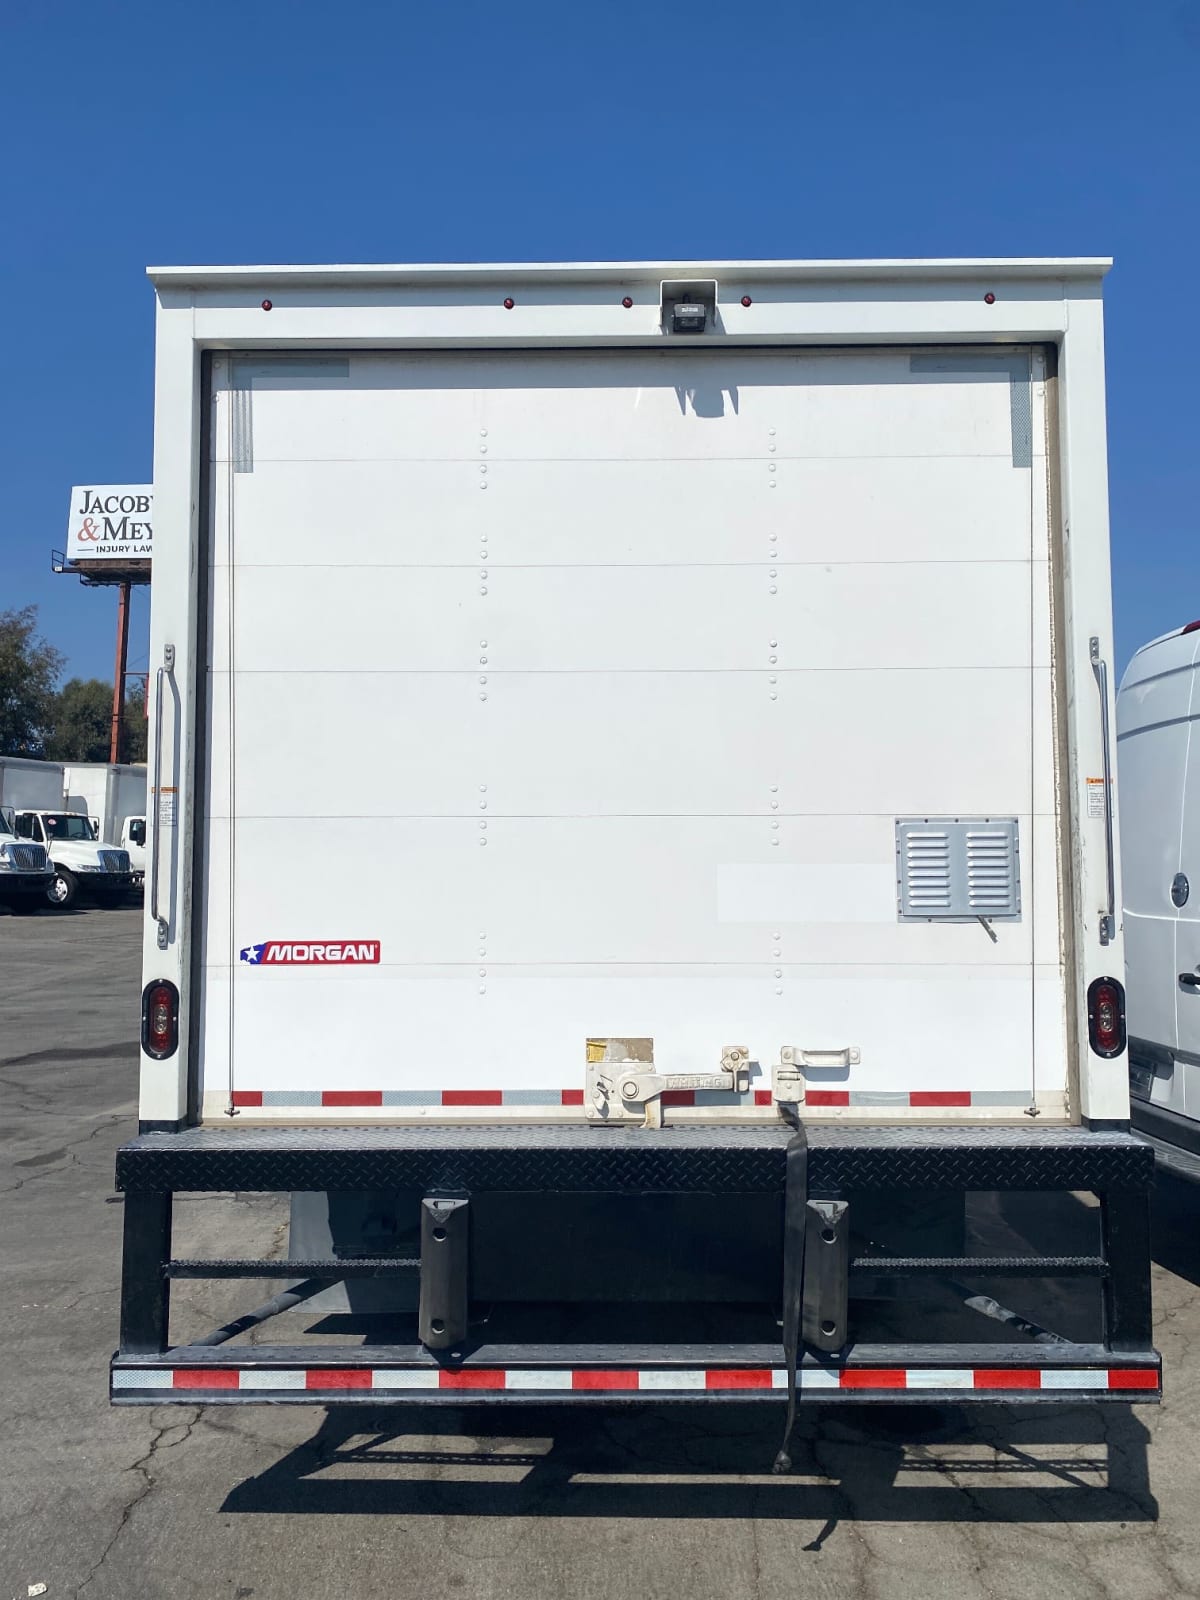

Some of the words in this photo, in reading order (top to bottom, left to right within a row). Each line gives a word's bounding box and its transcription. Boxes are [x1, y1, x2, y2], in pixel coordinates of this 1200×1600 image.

[79, 490, 153, 514] JACOB
[96, 545, 130, 553] INJURY
[266, 944, 375, 961] MORGAN
